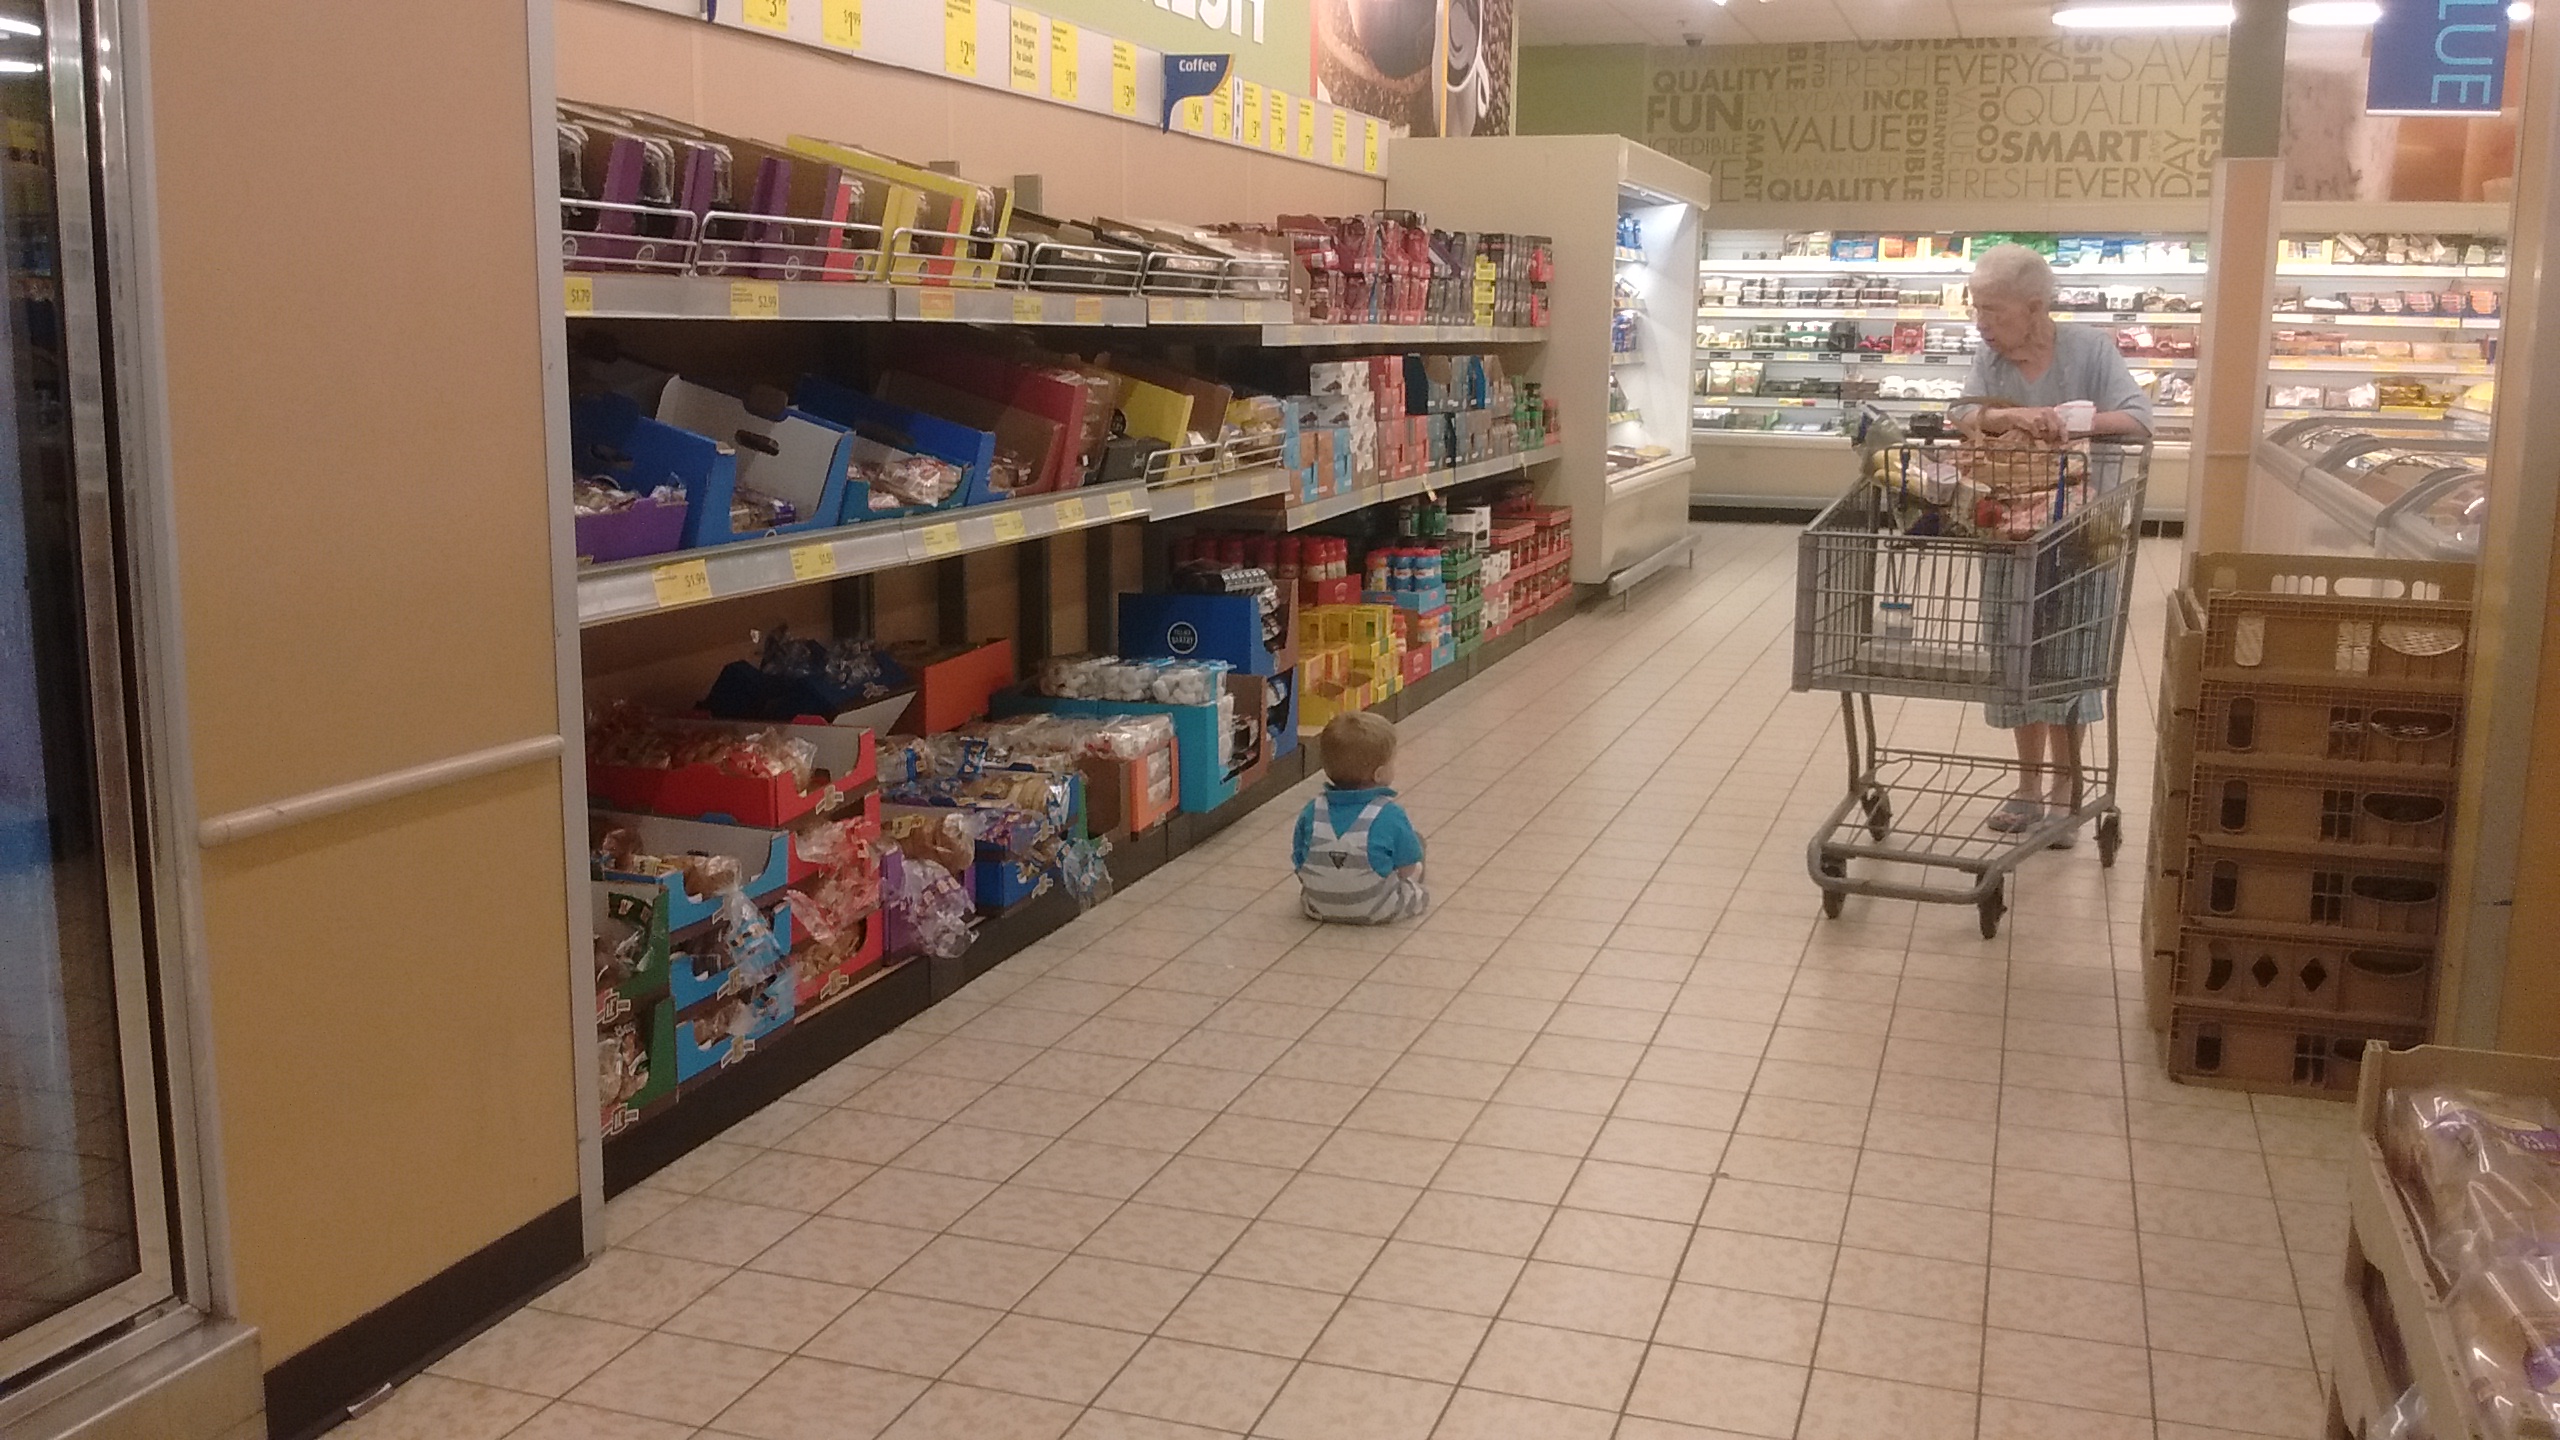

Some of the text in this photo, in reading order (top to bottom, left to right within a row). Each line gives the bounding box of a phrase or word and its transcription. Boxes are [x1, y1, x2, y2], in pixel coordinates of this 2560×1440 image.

[1178, 59, 1218, 73] Coffee
[2105, 35, 2228, 83] SAVE
[2430, 0, 2499, 104] LUE
[1652, 68, 1782, 93] QUALITY
[1828, 56, 1928, 88] FRESH
[1646, 94, 1744, 133] FUN
[1976, 85, 2001, 163] COOL
[2003, 84, 2201, 126] QUALITY
[1770, 115, 1903, 153] VALUE
[1929, 86, 1949, 199] GUARANTEED
[1948, 87, 1977, 164] VALUE
[1743, 118, 1766, 202] SMART
[2001, 130, 2148, 163] SMART
[1767, 177, 1899, 202] QUALITY
[1946, 167, 2049, 199] FRESH
[571, 289, 591, 303] $1.79
[684, 572, 706, 586] $1.99
